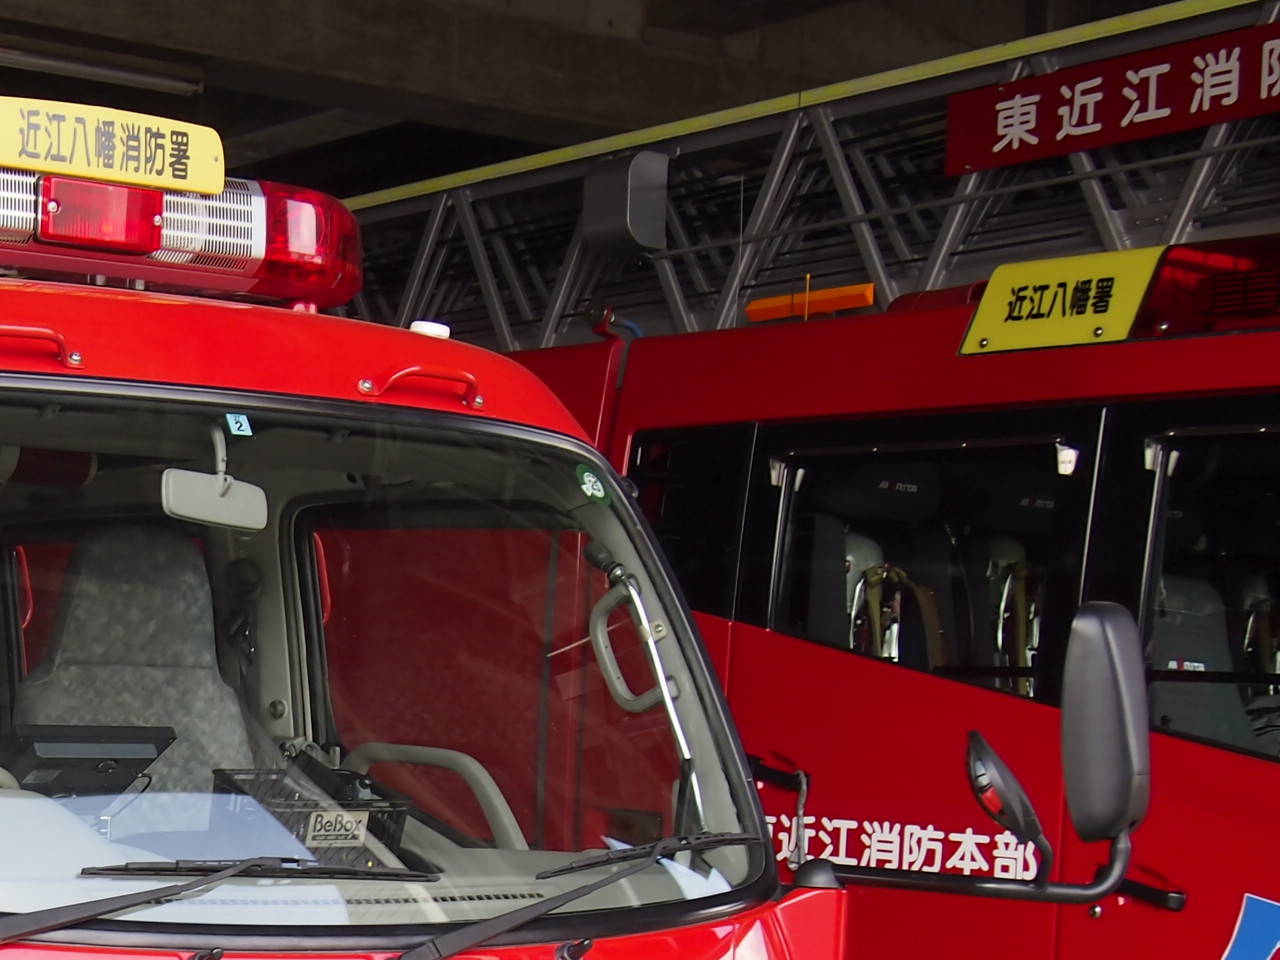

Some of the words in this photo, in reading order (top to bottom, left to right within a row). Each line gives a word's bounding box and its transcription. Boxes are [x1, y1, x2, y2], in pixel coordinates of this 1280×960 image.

[18, 107, 191, 180] 近江八幡消防署
[1004, 277, 1115, 322] 近江八幡署
[235, 420, 245, 431] 2
[312, 813, 362, 834] BeBox
[766, 813, 1039, 881] 近江消防本部
